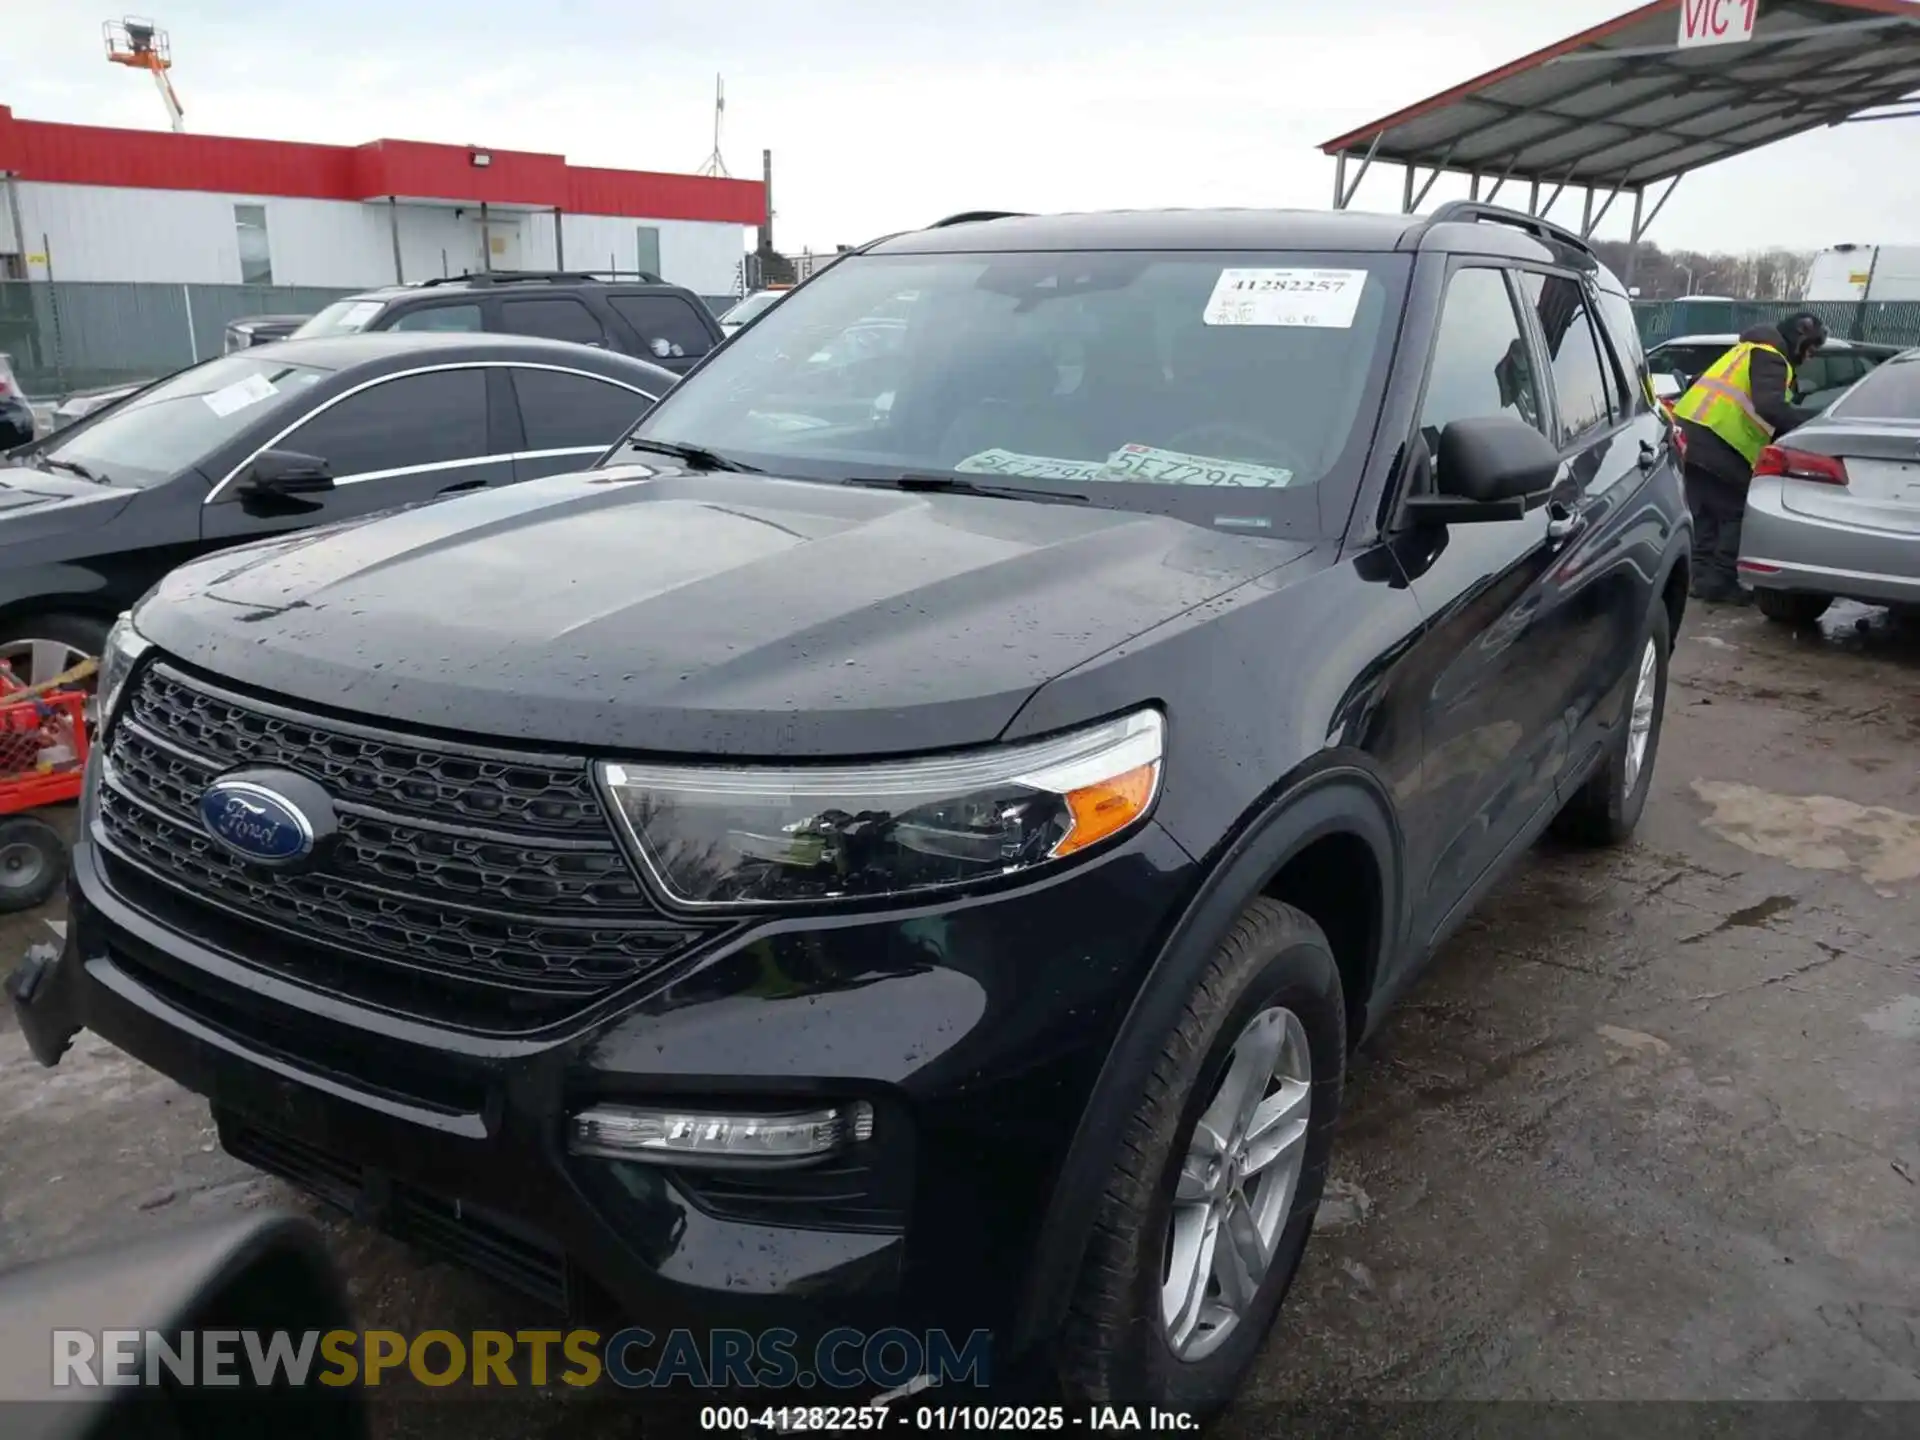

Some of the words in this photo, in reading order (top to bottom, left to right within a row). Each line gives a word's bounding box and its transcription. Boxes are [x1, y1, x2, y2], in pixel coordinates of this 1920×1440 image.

[1685, 0, 1729, 38] VIC
[1231, 279, 1347, 292] 41282257
[219, 797, 282, 848] Ford
